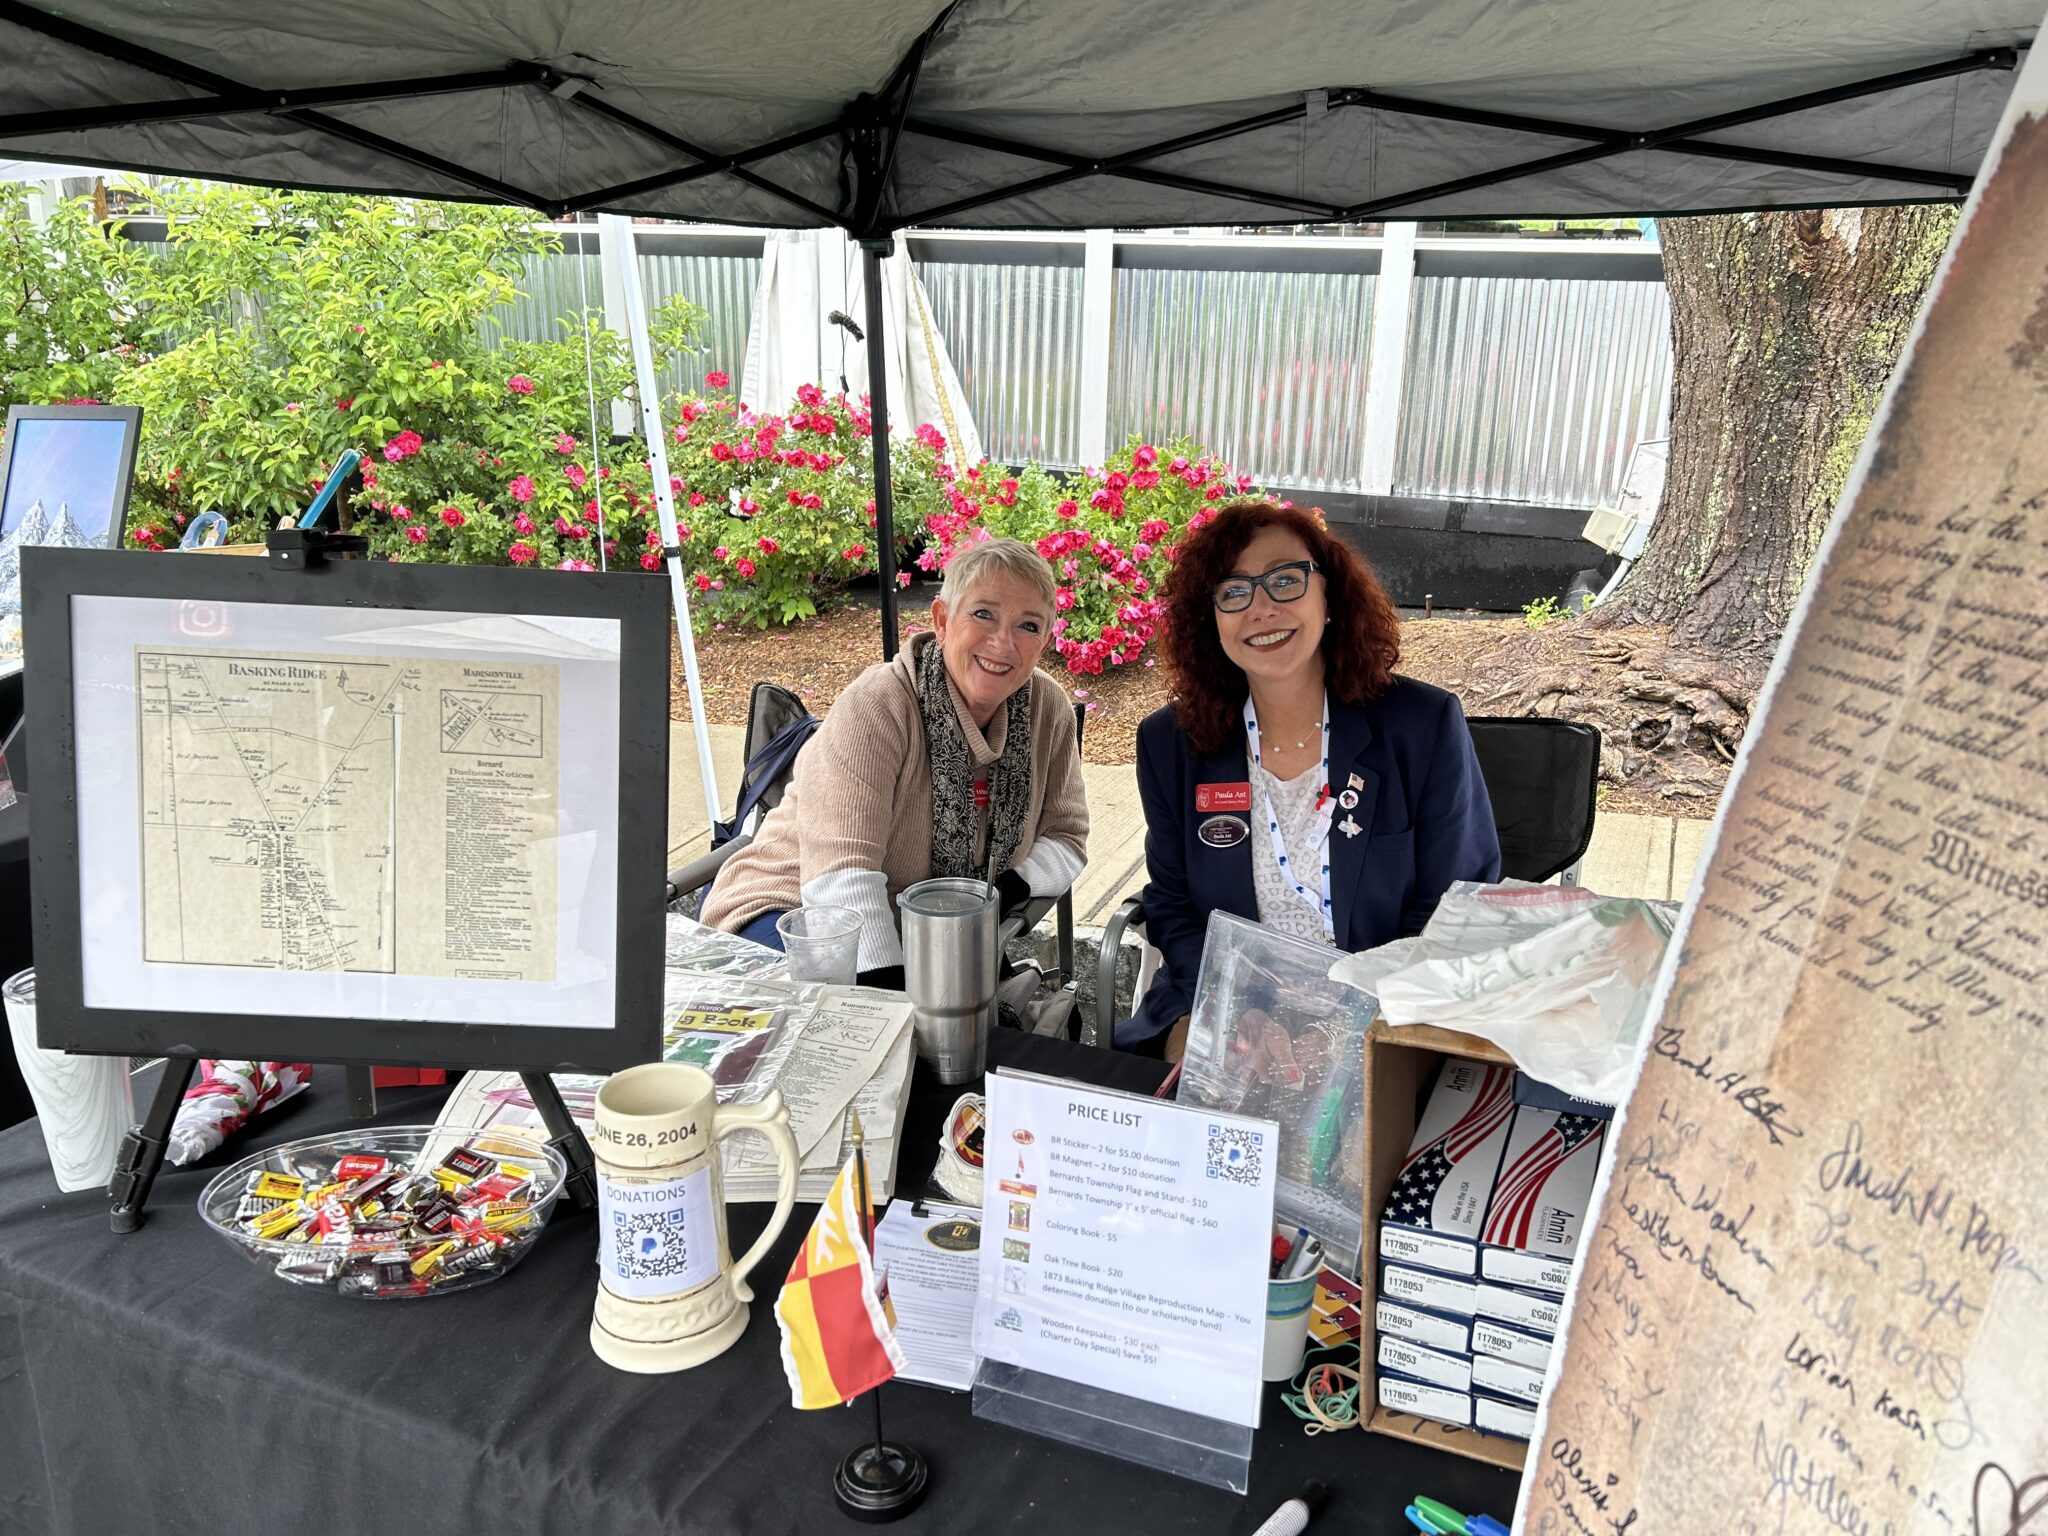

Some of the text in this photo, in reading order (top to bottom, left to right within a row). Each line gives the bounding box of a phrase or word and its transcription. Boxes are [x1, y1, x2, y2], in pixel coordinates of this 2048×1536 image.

[228, 663, 327, 680] BASKING RIDGE
[463, 668, 524, 679] MADISONVILLE
[1446, 1067, 1472, 1092] Annin
[1068, 1103, 1142, 1128] PRICE LIST
[626, 1133, 652, 1148] 26,
[657, 1122, 697, 1145] 2004
[1051, 1135, 1061, 1144] BR
[1064, 1138, 1089, 1150] Sticker
[1105, 1146, 1116, 1155] for
[1119, 1148, 1141, 1160] $5.00
[1143, 1152, 1180, 1167] donation
[1050, 1152, 1060, 1160] BR
[1062, 1155, 1092, 1168] Magnet
[1108, 1164, 1120, 1173] for
[1122, 1166, 1137, 1177] $10
[1139, 1170, 1176, 1184] donation
[607, 1186, 686, 1202] DONATIONS
[1050, 1169, 1208, 1209] Bernards Township Flag and Stand $10
[1049, 1186, 1083, 1201] Bernards
[1085, 1193, 1123, 1209] Township
[1150, 1207, 1178, 1220] official
[1179, 1213, 1195, 1225] flag
[1202, 1218, 1218, 1228] $60
[1046, 1220, 1117, 1242] Coloring Book $5
[1546, 1208, 1575, 1244] Annin
[1385, 1239, 1419, 1253] 1178053
[1044, 1254, 1123, 1278] Oak Tree Book $20
[1540, 1271, 1567, 1285] 78053
[1389, 1277, 1423, 1292] 1178053
[1042, 1284, 1223, 1333] determine donation (to our scholarship fund)
[1043, 1271, 1251, 1325] 1873 Basking Ridge Village Reproduction Map You
[1379, 1312, 1413, 1328] 1178053
[1531, 1308, 1559, 1323] 78053
[1040, 1329, 1072, 1345] (Charter
[1074, 1336, 1088, 1348] Day
[1090, 1341, 1121, 1358] Special)
[1123, 1349, 1141, 1361] Save
[1041, 1317, 1160, 1351] Wooden Keepsakes $30 each
[1477, 1332, 1512, 1350] 1178053
[1384, 1347, 1417, 1365] 1178053
[1383, 1388, 1417, 1402] 1178053
